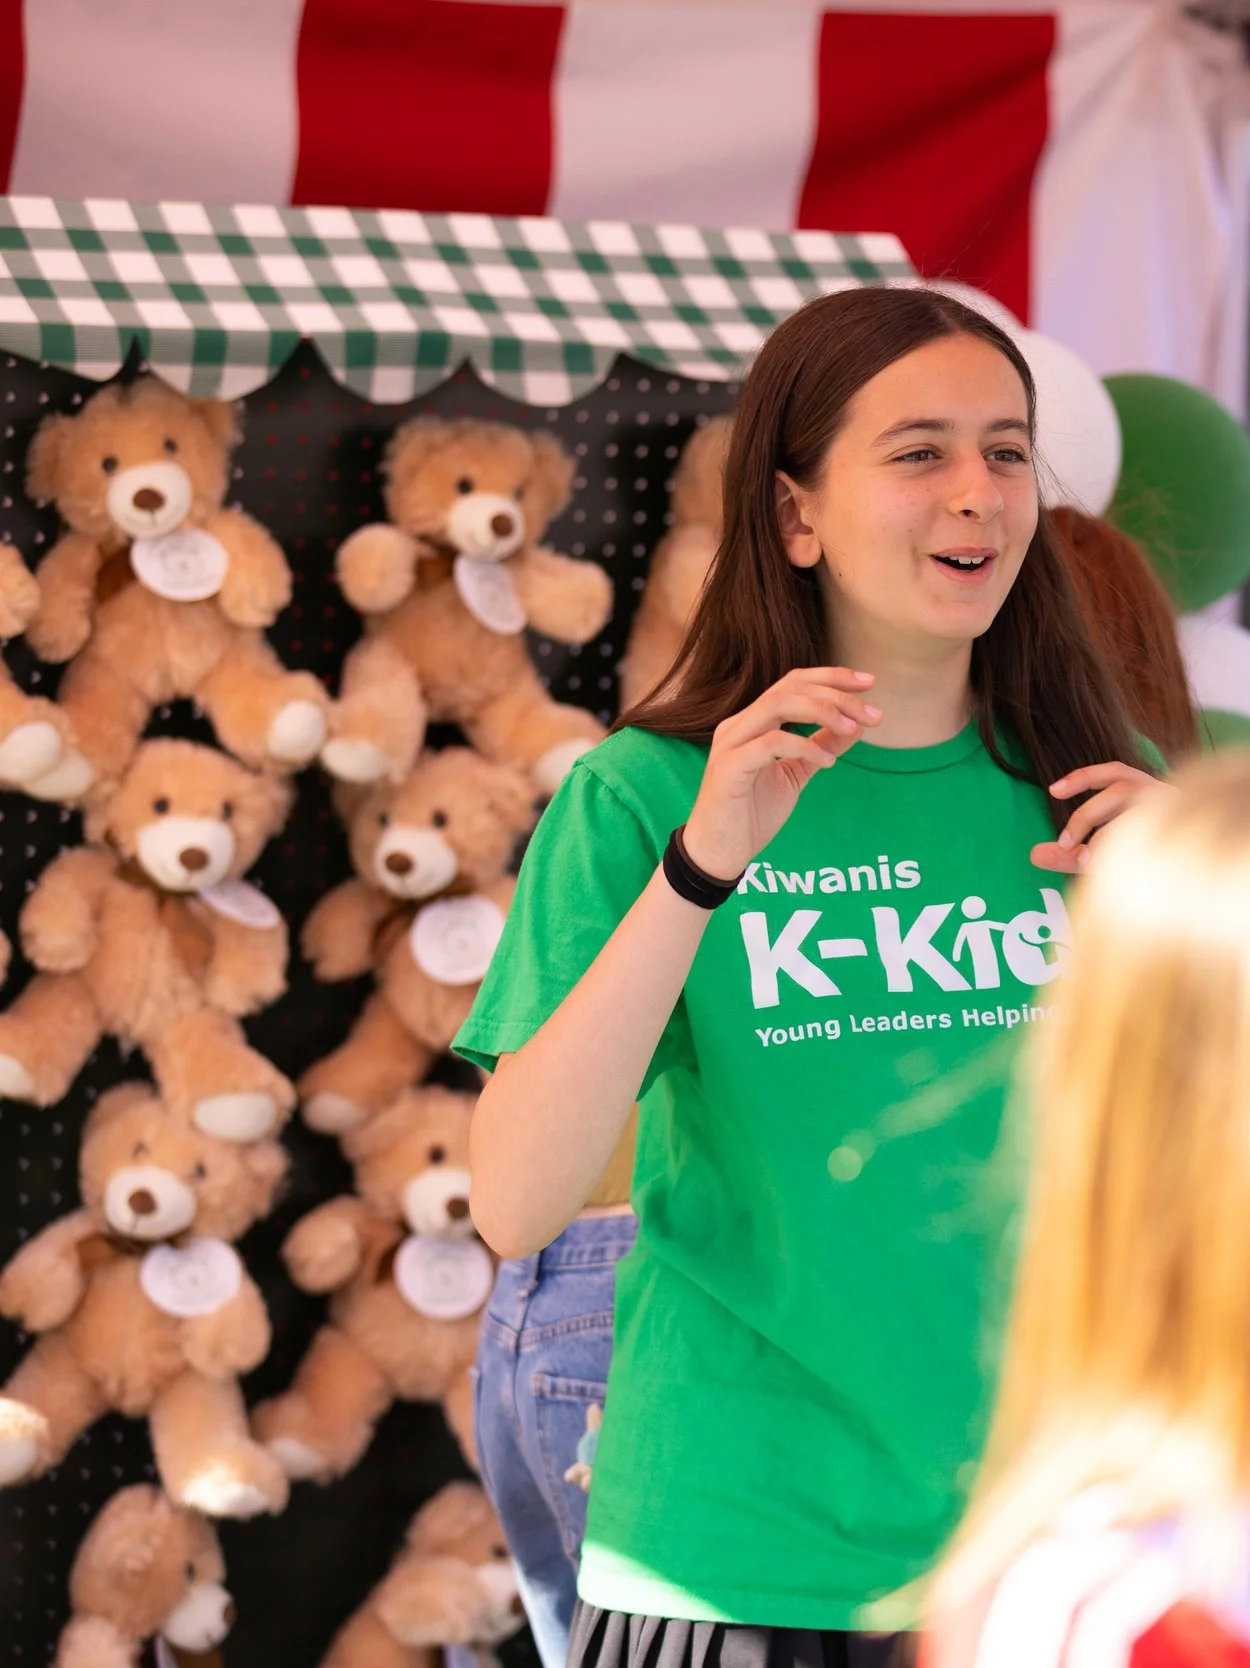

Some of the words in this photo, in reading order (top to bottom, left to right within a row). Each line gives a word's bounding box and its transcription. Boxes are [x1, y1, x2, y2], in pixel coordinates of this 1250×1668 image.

[737, 855, 921, 895] Kiwanis
[755, 1019, 841, 1047] Young
[849, 1010, 952, 1033] Leaders
